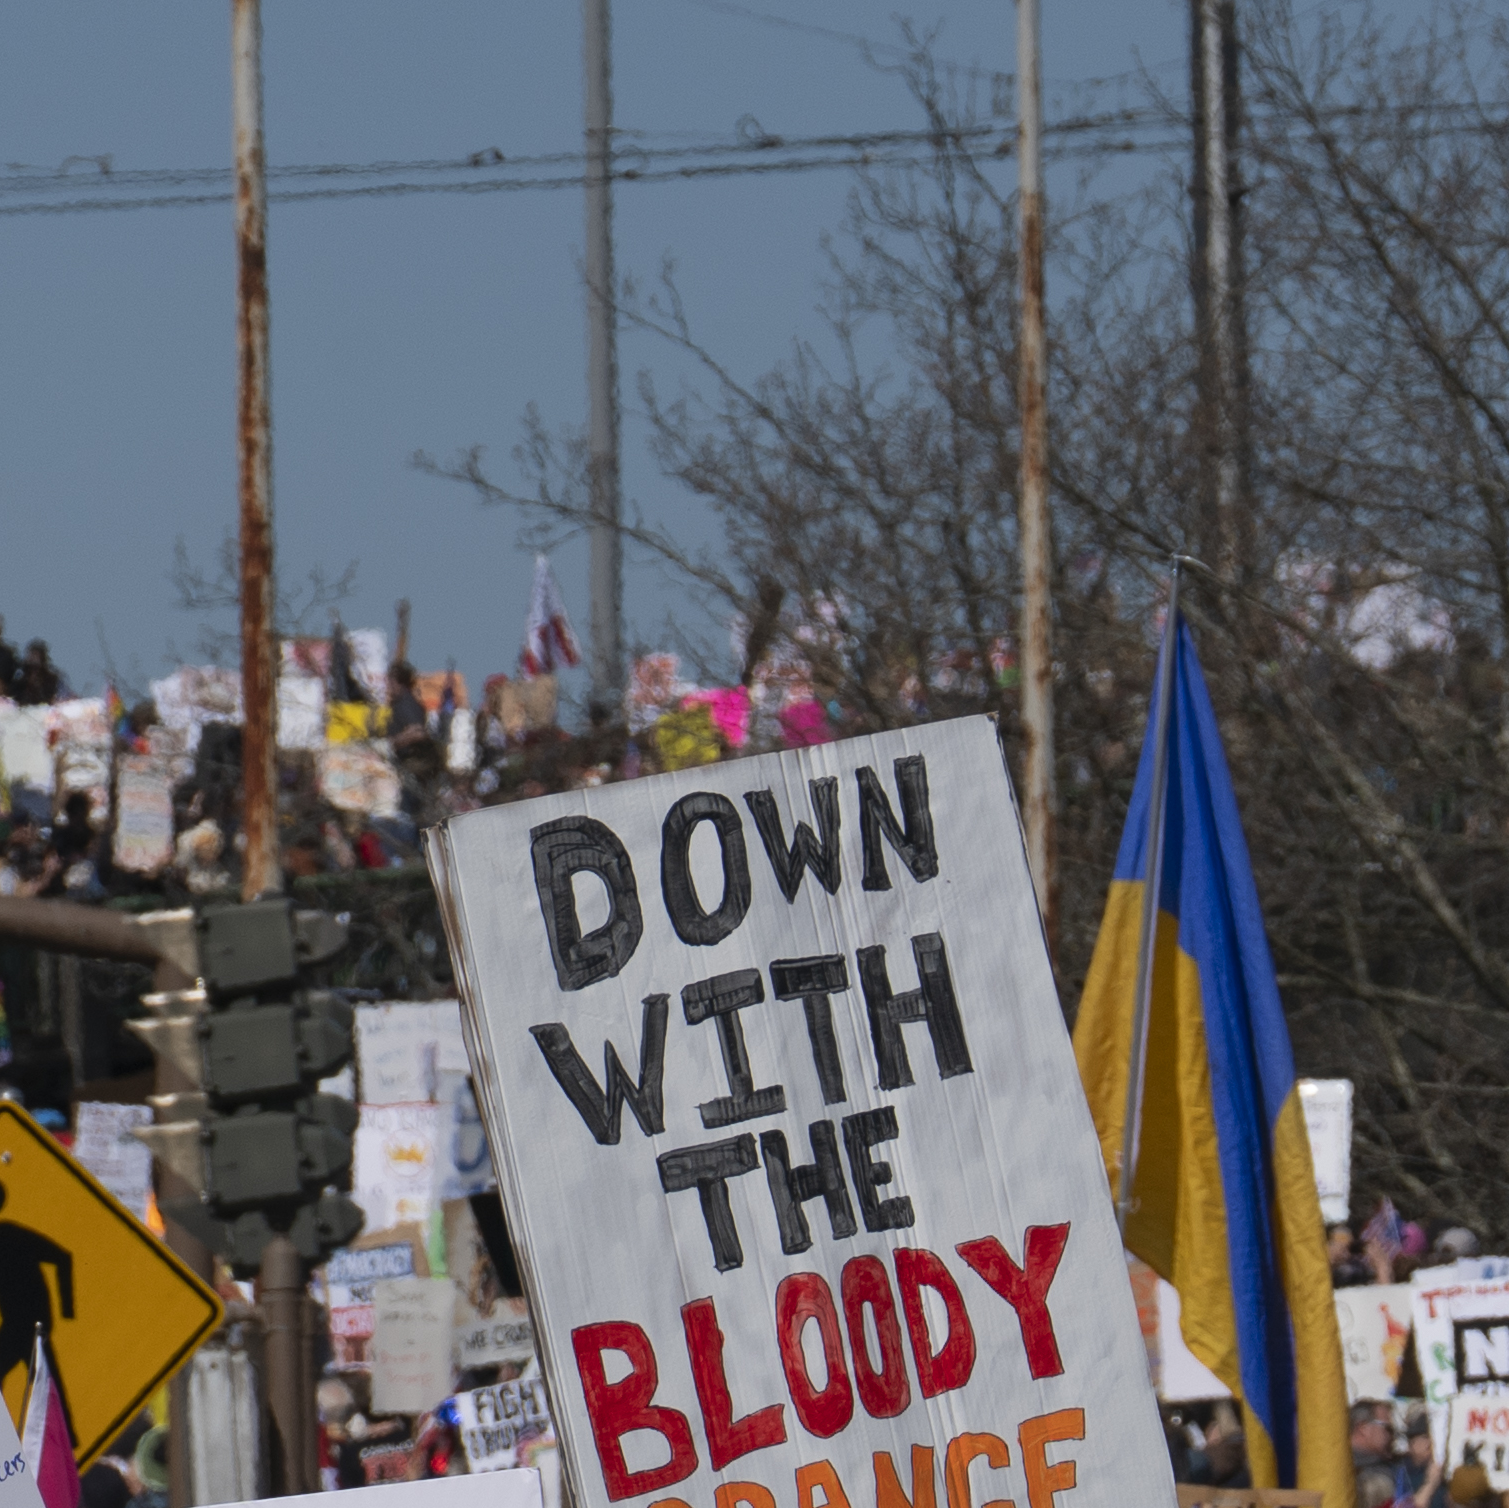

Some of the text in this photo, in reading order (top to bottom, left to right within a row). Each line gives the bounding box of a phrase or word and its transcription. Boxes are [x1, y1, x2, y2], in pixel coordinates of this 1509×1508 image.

[529, 754, 938, 992] DOWN
[529, 932, 974, 1147] WITH
[656, 1106, 915, 1272] THE
[570, 1221, 1071, 1502] BLOODY
